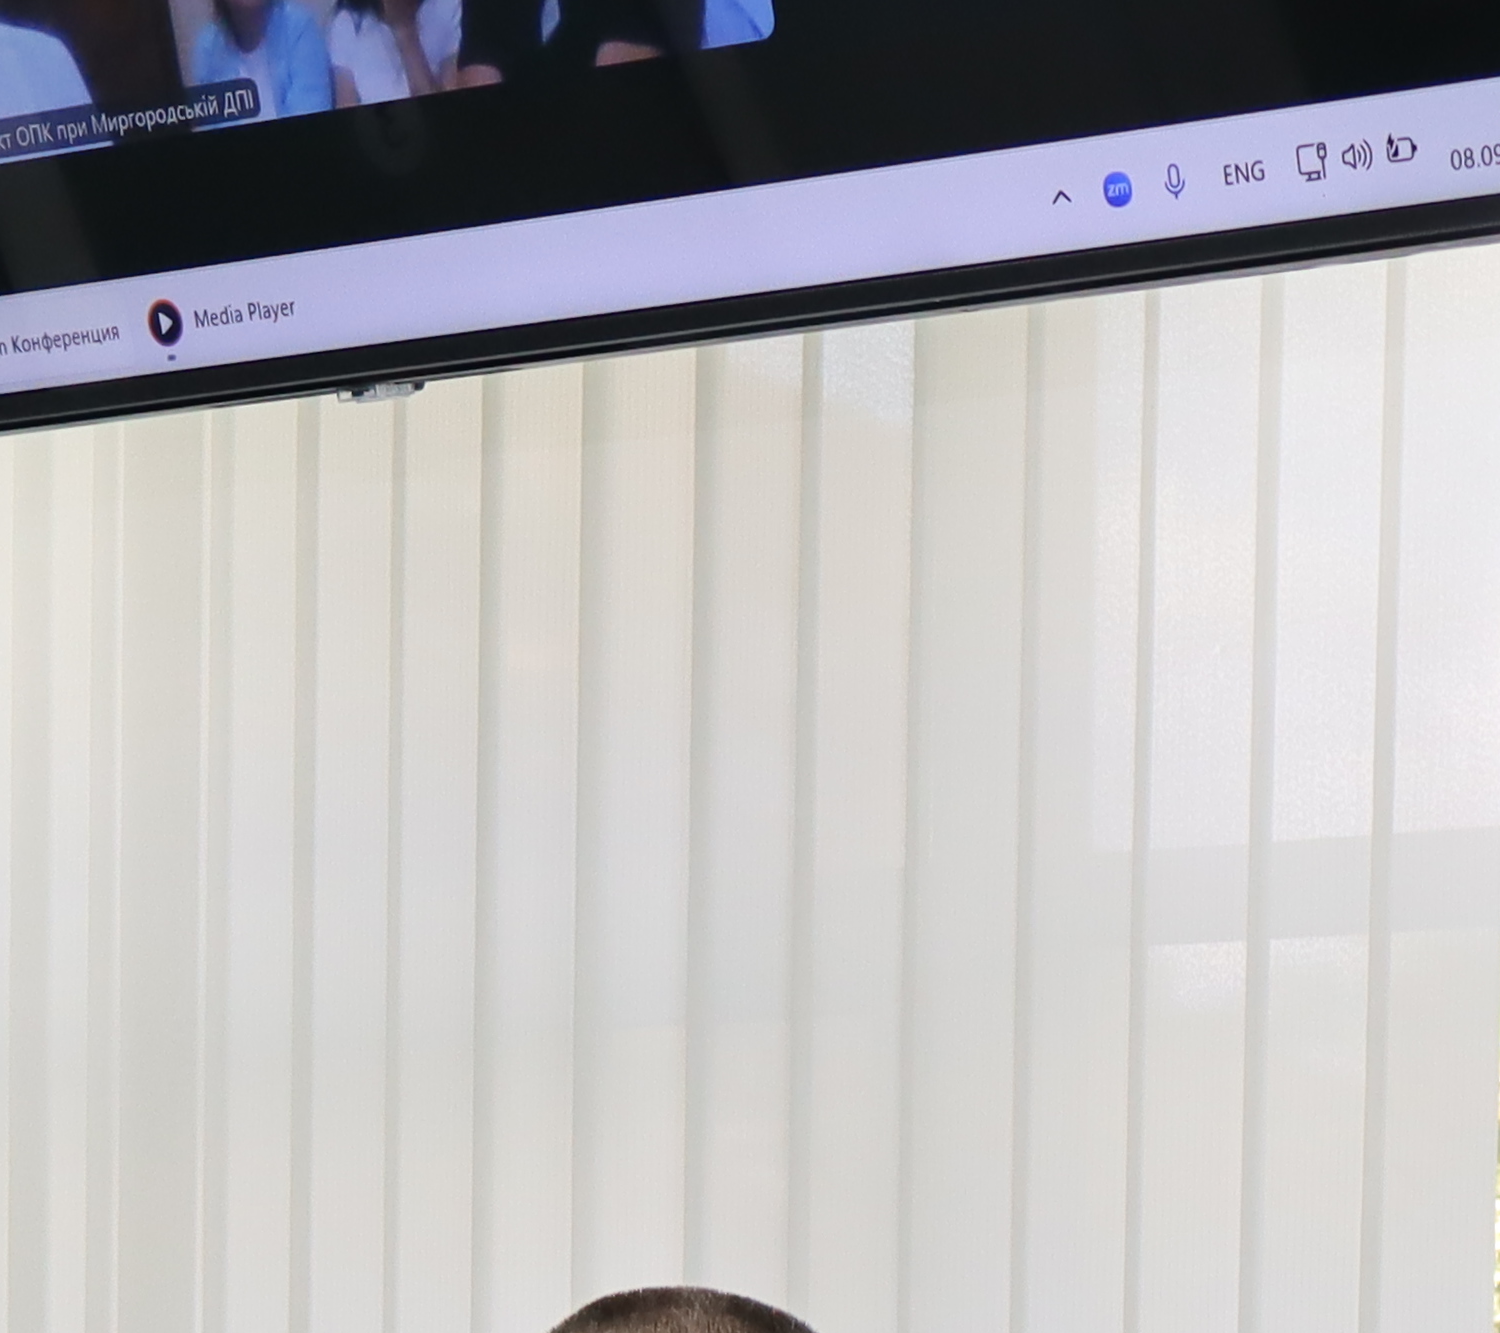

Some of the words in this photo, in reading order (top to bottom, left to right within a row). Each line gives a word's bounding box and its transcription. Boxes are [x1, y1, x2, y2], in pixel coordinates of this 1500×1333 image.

[16, 122, 52, 148] ОПК
[57, 121, 88, 147] при
[92, 93, 219, 142] Миргородській
[224, 88, 254, 118] ДПІ
[1223, 160, 1266, 187] ENG
[1107, 181, 1129, 198] zm
[193, 304, 243, 328] Media
[247, 301, 296, 323] Player
[11, 326, 121, 354] Конференция
